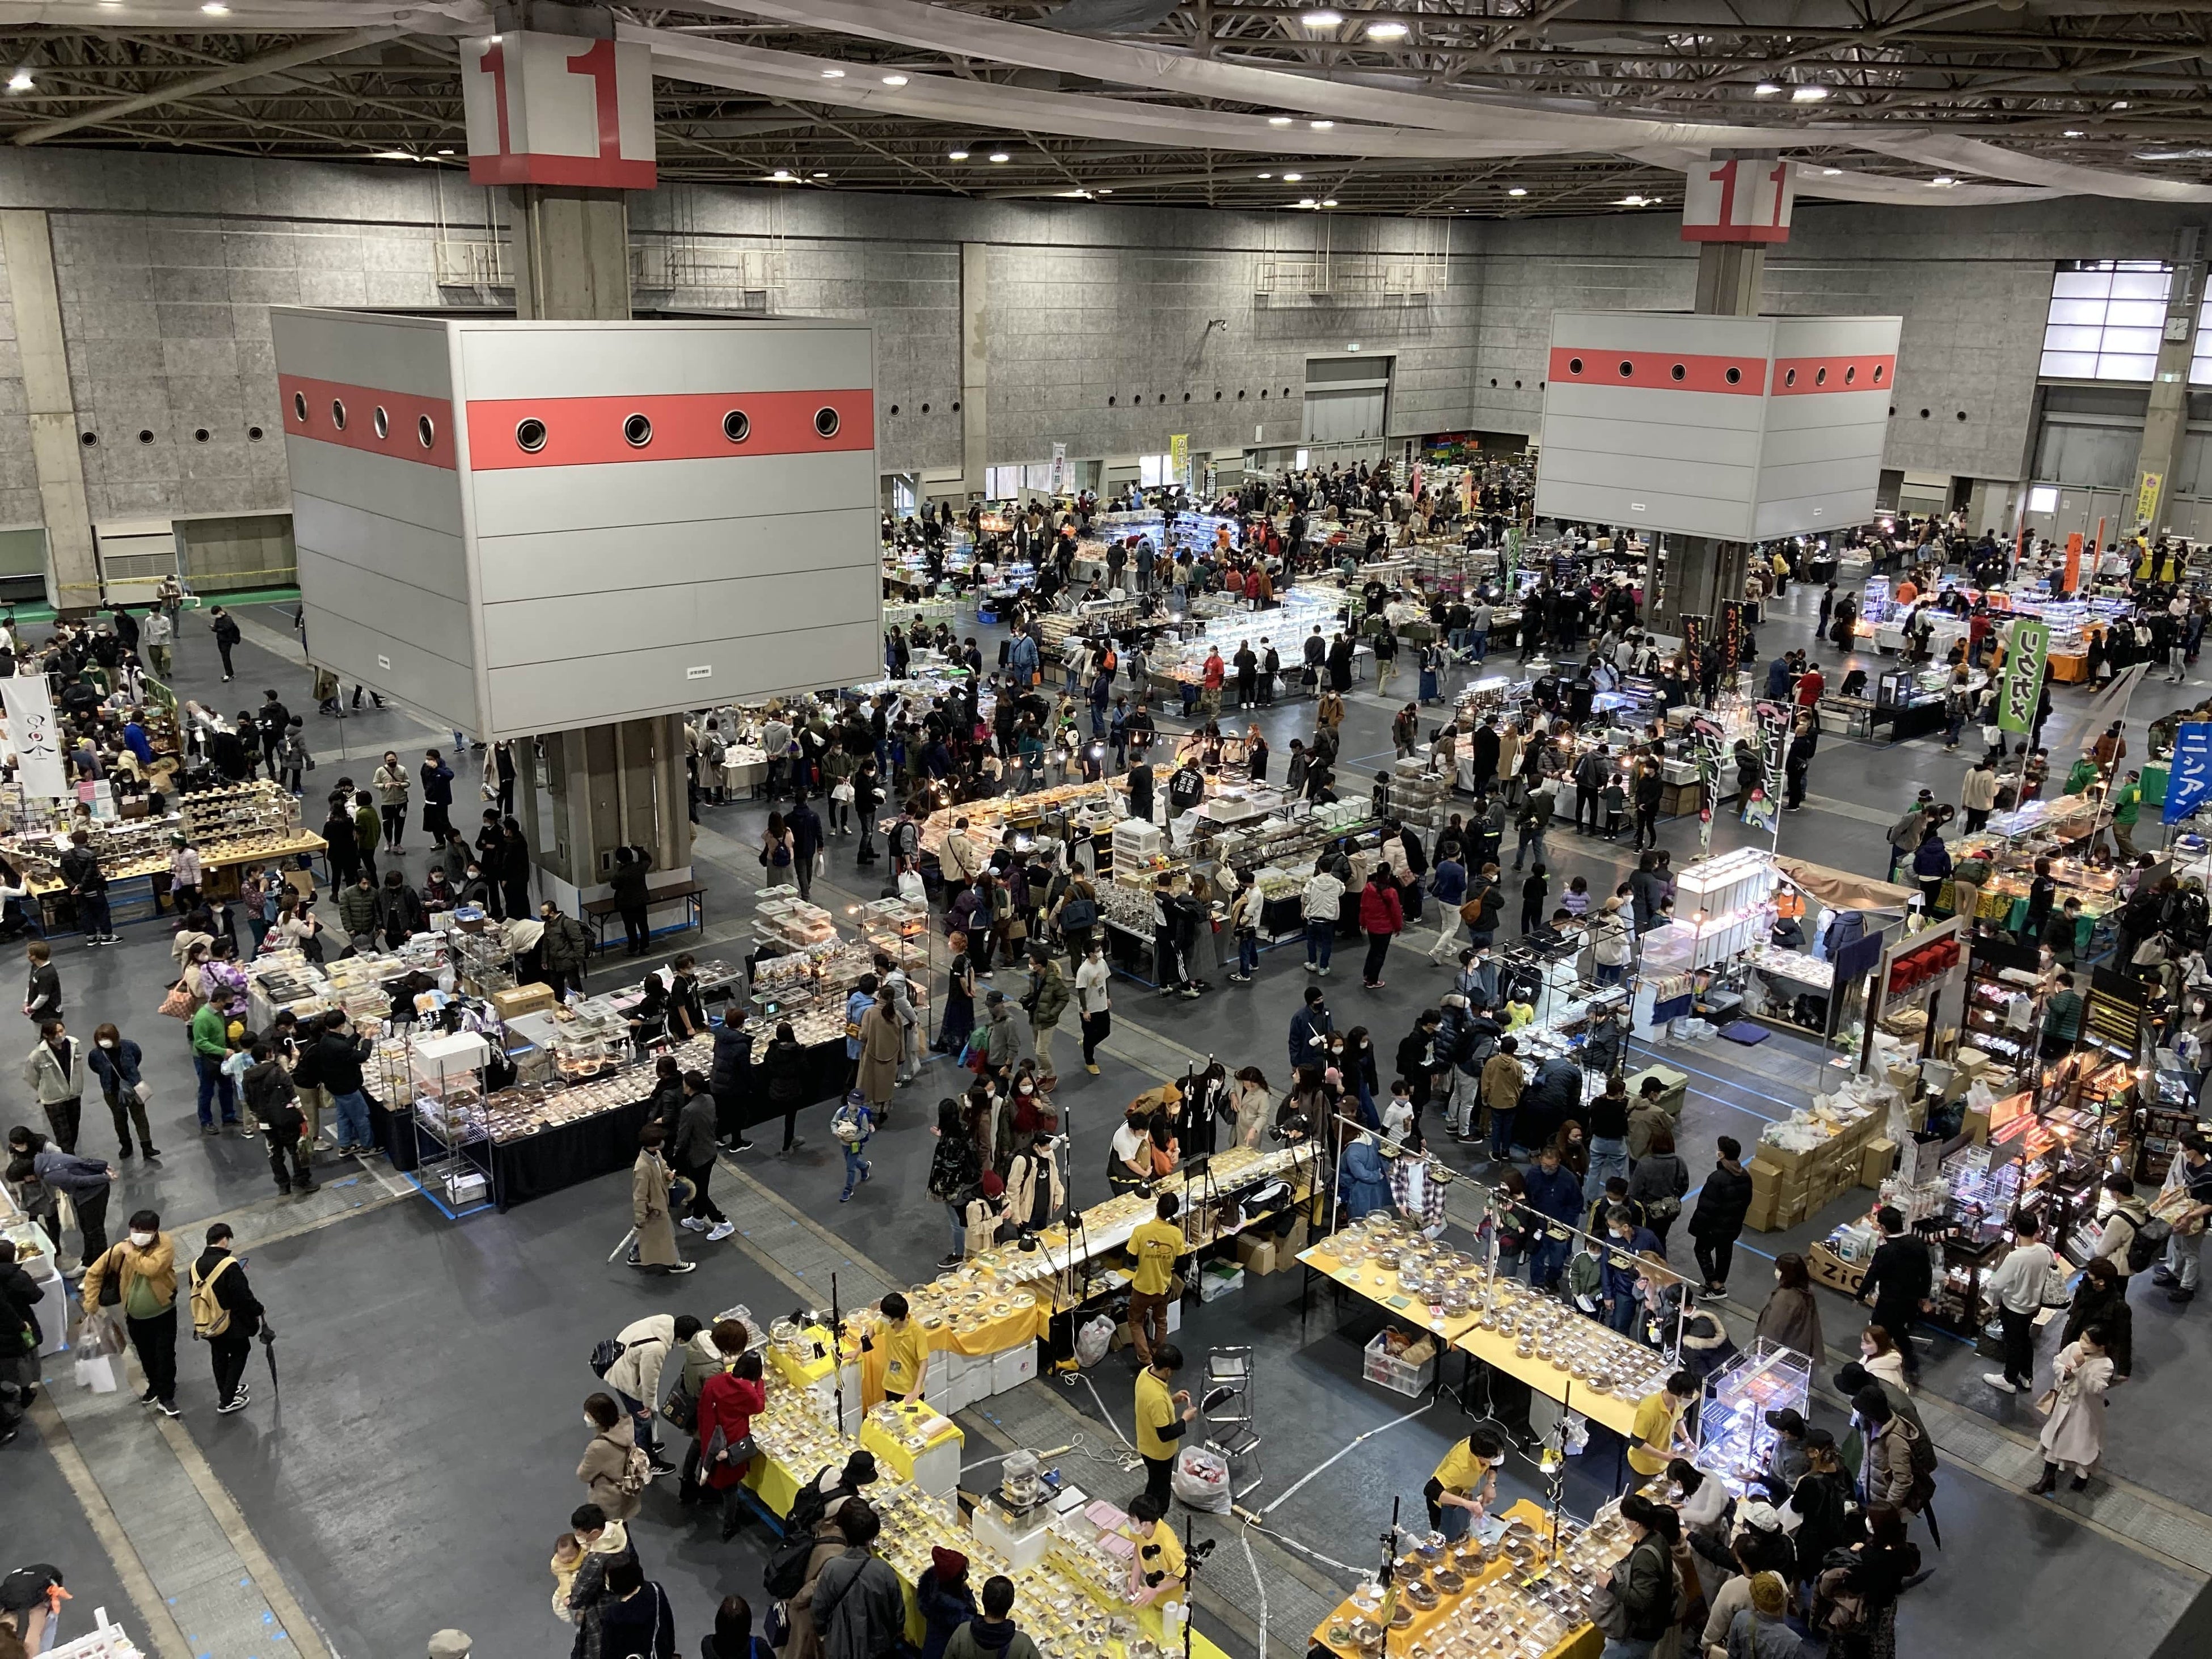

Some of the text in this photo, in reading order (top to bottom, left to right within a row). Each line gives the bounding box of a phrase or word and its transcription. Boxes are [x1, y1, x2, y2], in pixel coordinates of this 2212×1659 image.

[567, 40, 622, 160] 1
[1709, 159, 1738, 226] 1
[1770, 162, 1787, 226] 1
[1177, 437, 1186, 465] カエル
[1726, 607, 1737, 668] カメレオン
